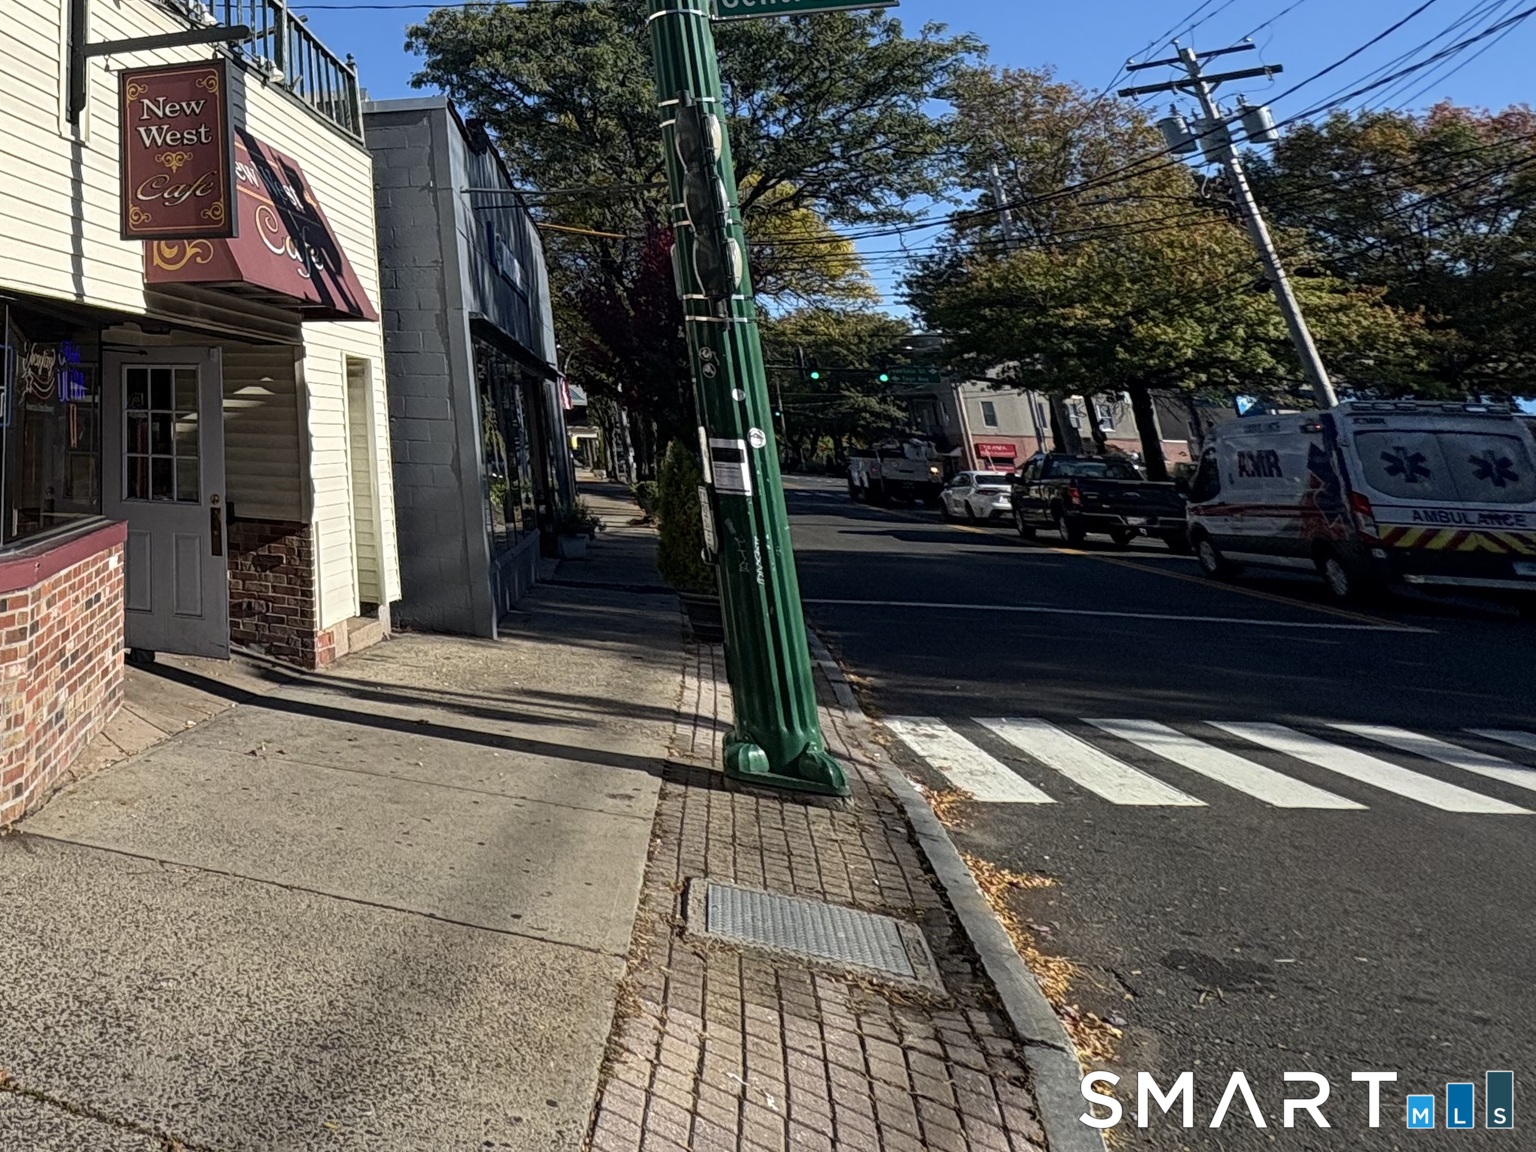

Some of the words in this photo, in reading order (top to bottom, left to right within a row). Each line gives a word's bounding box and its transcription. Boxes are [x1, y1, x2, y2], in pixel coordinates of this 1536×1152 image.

[139, 96, 206, 120] New
[136, 123, 213, 148] West
[136, 170, 218, 207] Cafe
[254, 204, 324, 279] Cafe
[1237, 450, 1284, 477] AMR
[1412, 509, 1528, 527] AMBULANCE
